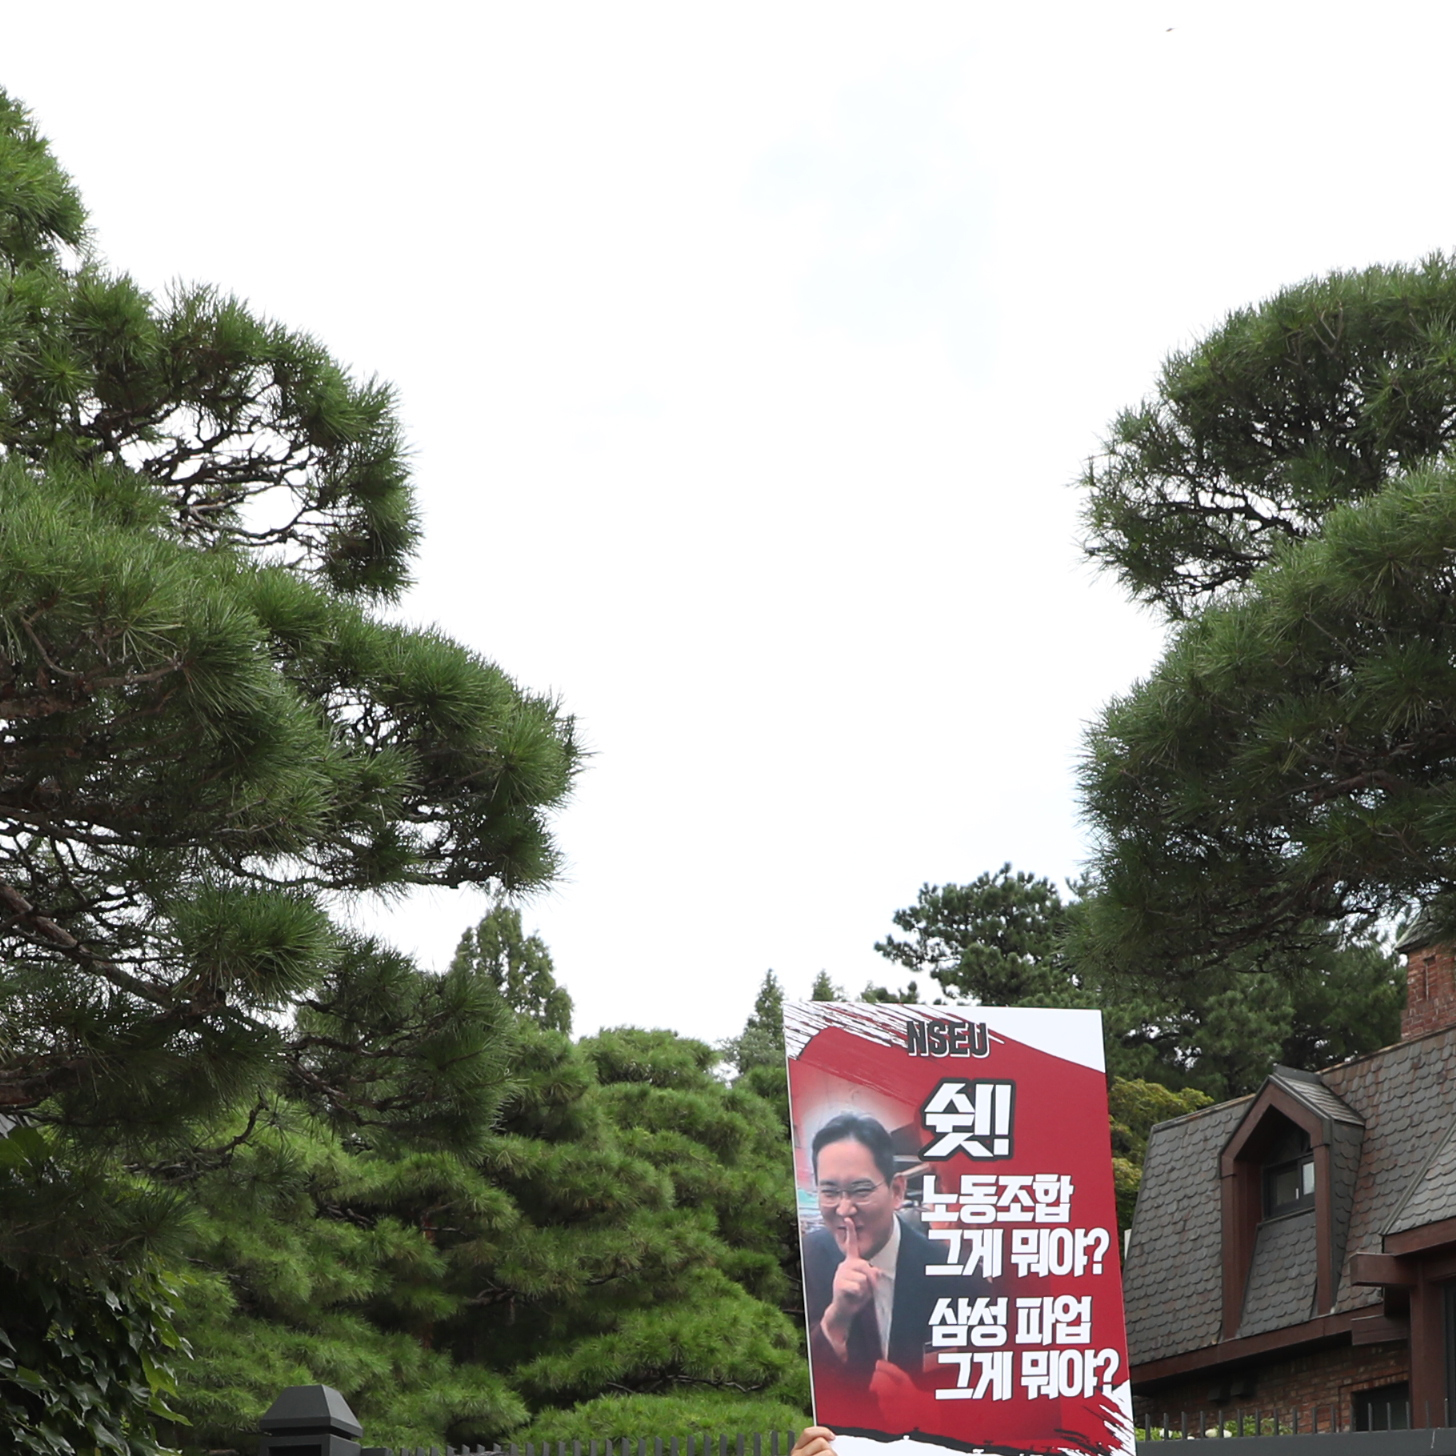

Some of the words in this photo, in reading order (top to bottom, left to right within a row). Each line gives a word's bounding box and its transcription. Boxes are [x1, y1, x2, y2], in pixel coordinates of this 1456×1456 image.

[907, 1021, 990, 1058] NSEU
[920, 1079, 1015, 1160] 쉿!
[921, 1174, 1073, 1224] 노동조합
[925, 1229, 1003, 1278] 그게
[1011, 1228, 1110, 1277] 뭐야?
[929, 1297, 1008, 1347] 삼성
[1014, 1296, 1092, 1346] 파업
[935, 1352, 1013, 1401] 그게
[1021, 1350, 1120, 1399] 뭐야?
